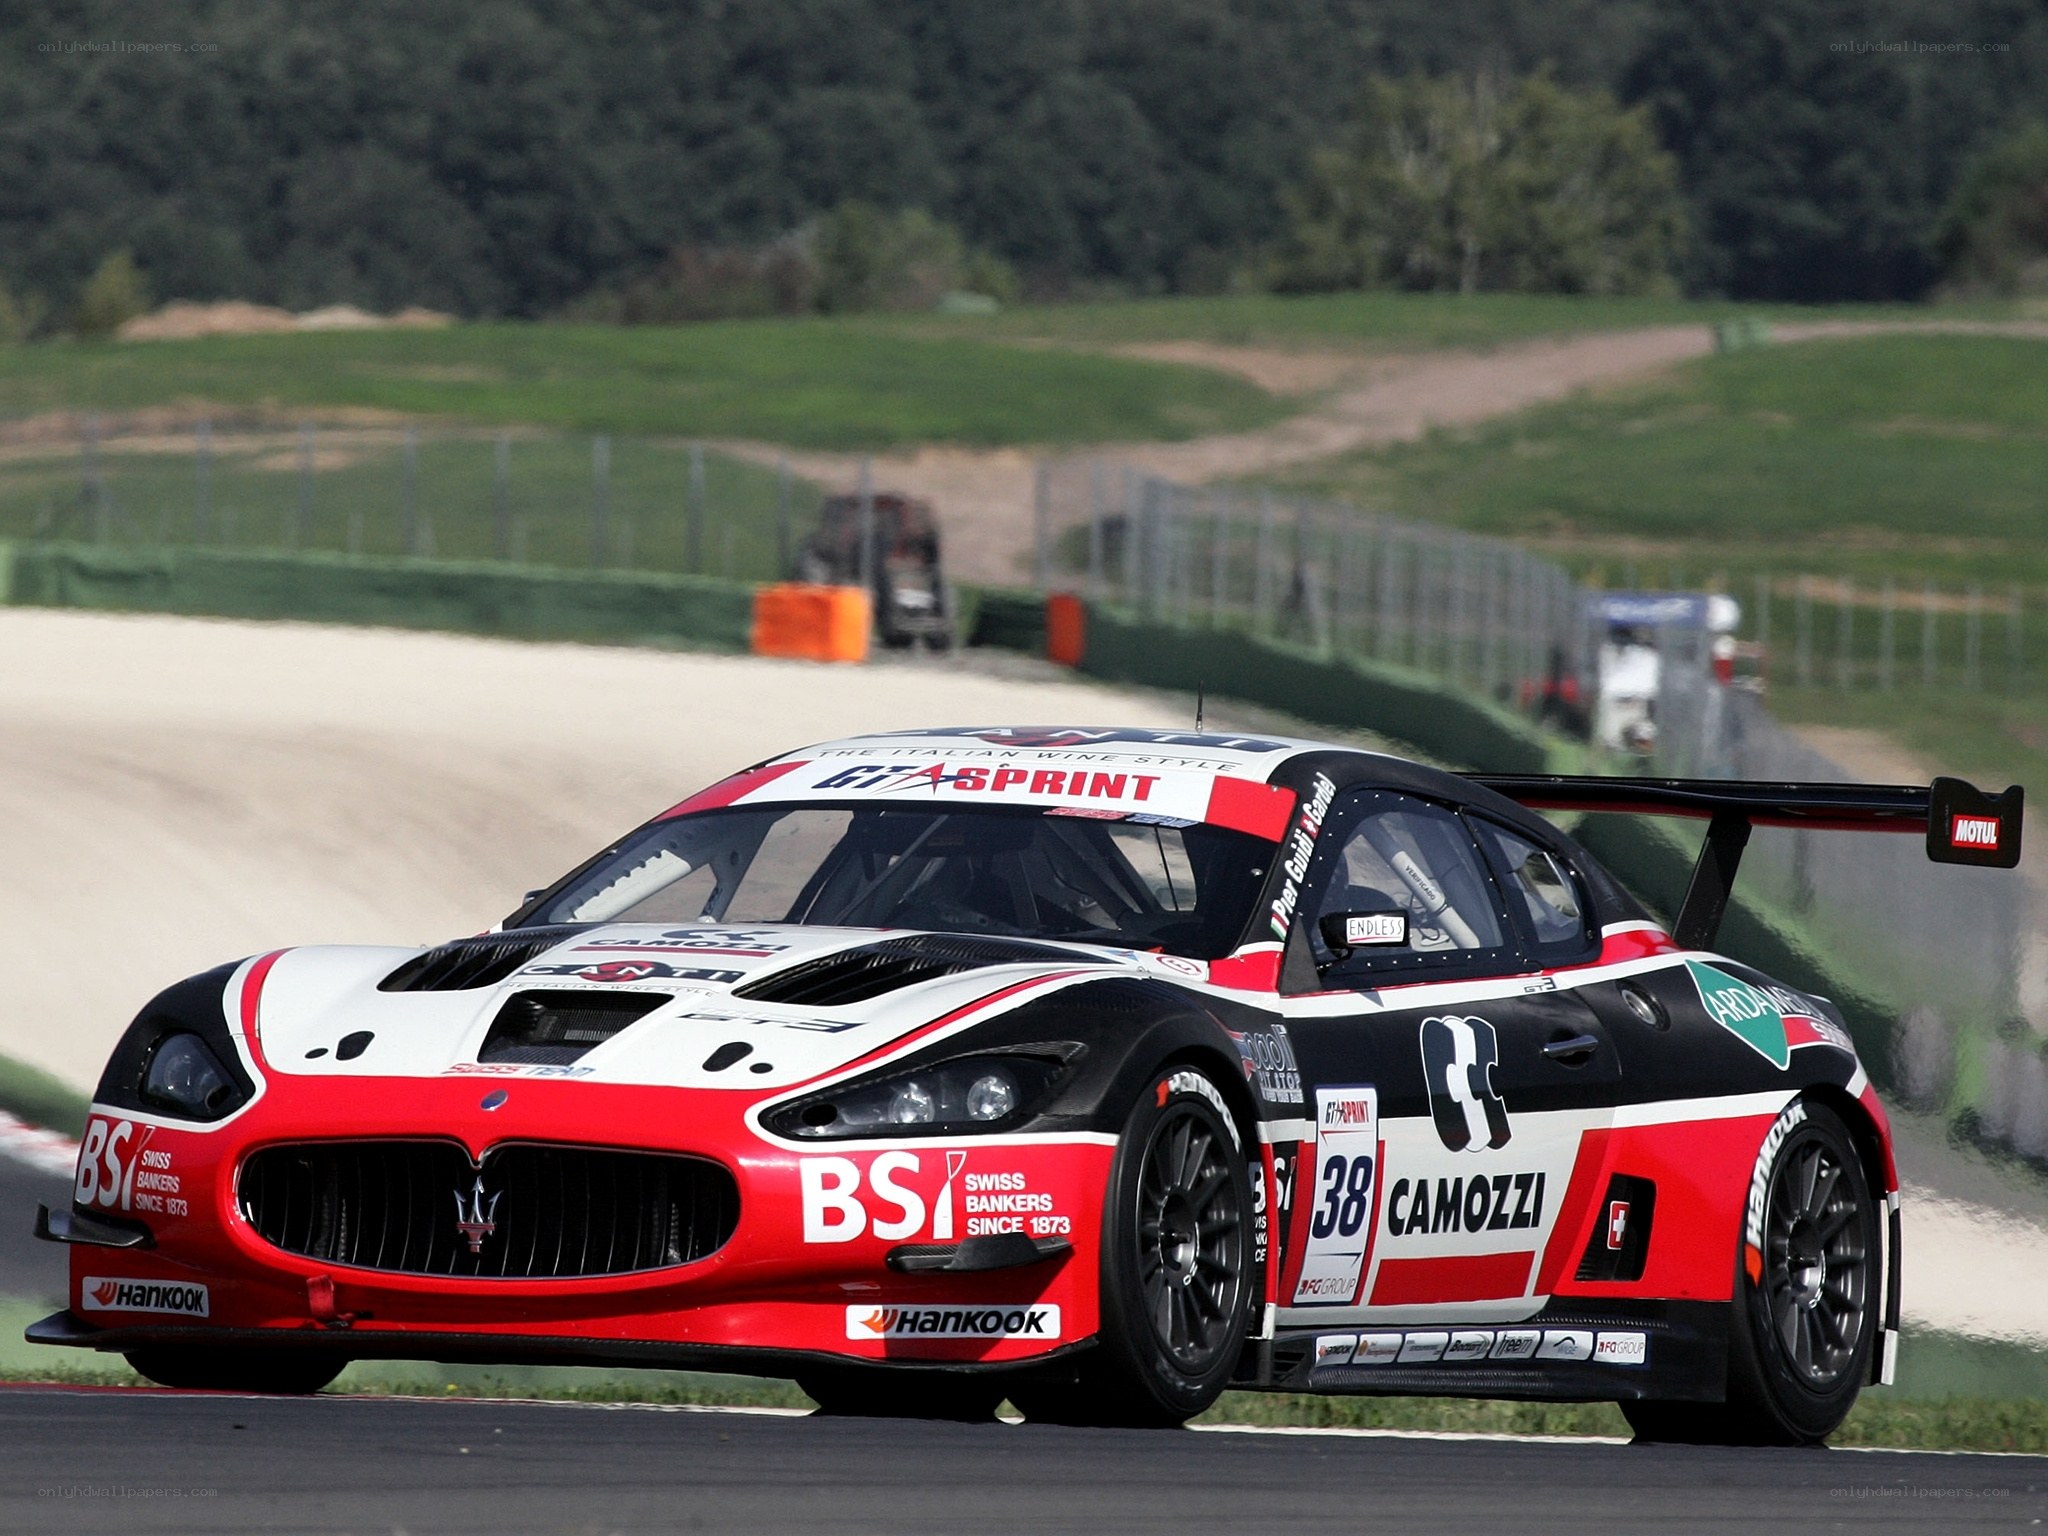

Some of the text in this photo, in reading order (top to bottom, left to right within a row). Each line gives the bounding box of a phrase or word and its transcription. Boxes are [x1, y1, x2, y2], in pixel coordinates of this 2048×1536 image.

[819, 748, 1237, 772] THE ITALIAN WINE STYLE
[953, 767, 1161, 801] SPRINT
[1302, 771, 1337, 827] Gardel
[1955, 819, 1997, 844] MOTUL
[1272, 828, 1315, 925] Pier Guidi
[1349, 918, 1403, 936] ENDLESS
[588, 938, 792, 951] CAMOZZI
[523, 965, 727, 980] CANTI
[1524, 976, 1557, 993] GT3
[141, 1150, 171, 1170] SWISS
[136, 1171, 180, 1193] BANKERS
[964, 1172, 1026, 1191] SWISS
[135, 1193, 188, 1217] SINCE 1873
[965, 1193, 1053, 1213] BANKERS
[1311, 1154, 1374, 1240] 38
[1387, 1171, 1546, 1237] CAMOZZI
[966, 1216, 1071, 1236] SINCE 1873
